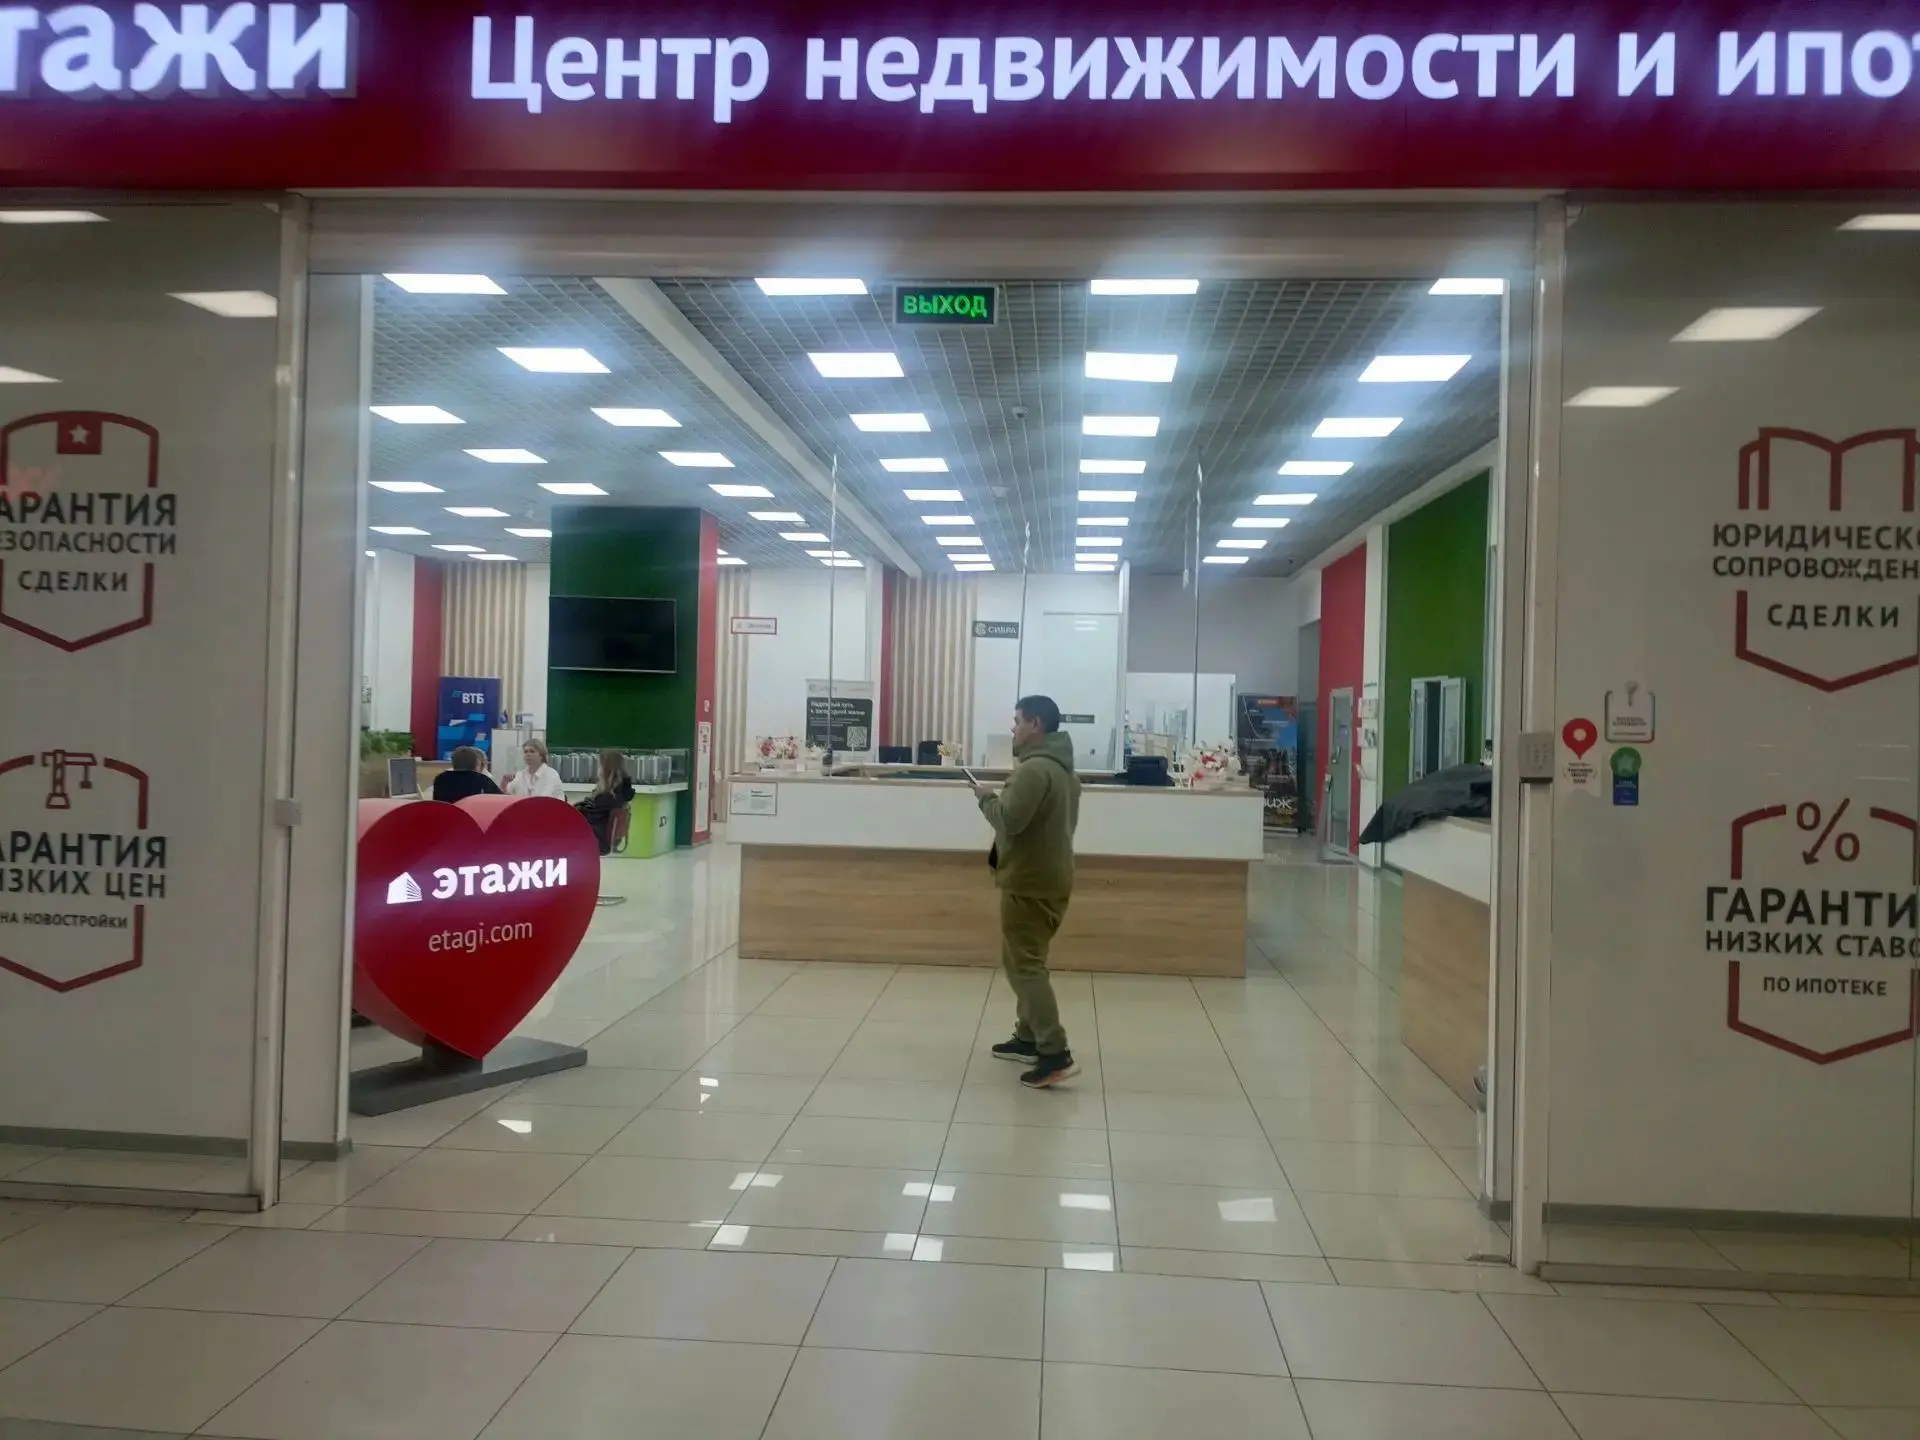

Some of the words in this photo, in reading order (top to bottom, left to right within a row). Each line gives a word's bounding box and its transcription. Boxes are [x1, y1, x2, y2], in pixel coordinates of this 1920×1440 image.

[471, 16, 769, 123] Центр
[805, 33, 1575, 114] недвижимости
[1616, 32, 1676, 97] и
[1717, 30, 1920, 98] ипо
[903, 294, 987, 318] ВЫХОД
[0, 530, 176, 555] ЗОПАСНОСТИ
[1712, 523, 1920, 551] ЮРИДИЧЕСК
[18, 570, 128, 593] СДЕЛКИ
[1712, 555, 1920, 582] СОПРОВОЖДЕН
[1767, 604, 1900, 629] СДЕЛКИ
[462, 692, 485, 705] ВТБ
[0, 830, 167, 869] РАНТИЯ
[0, 868, 90, 895] ЗКИХ
[105, 872, 166, 900] ЦЕН
[431, 858, 568, 899] этажи
[1706, 886, 1917, 928] ГАРАНТИ
[24, 912, 128, 929] НОВОСТРОЙКИ
[428, 922, 533, 953] etagi.com
[1706, 930, 1823, 956] НИЗКИХ
[1763, 976, 1790, 992] ПО
[1796, 977, 1887, 996] ИПОТЕКЕ
